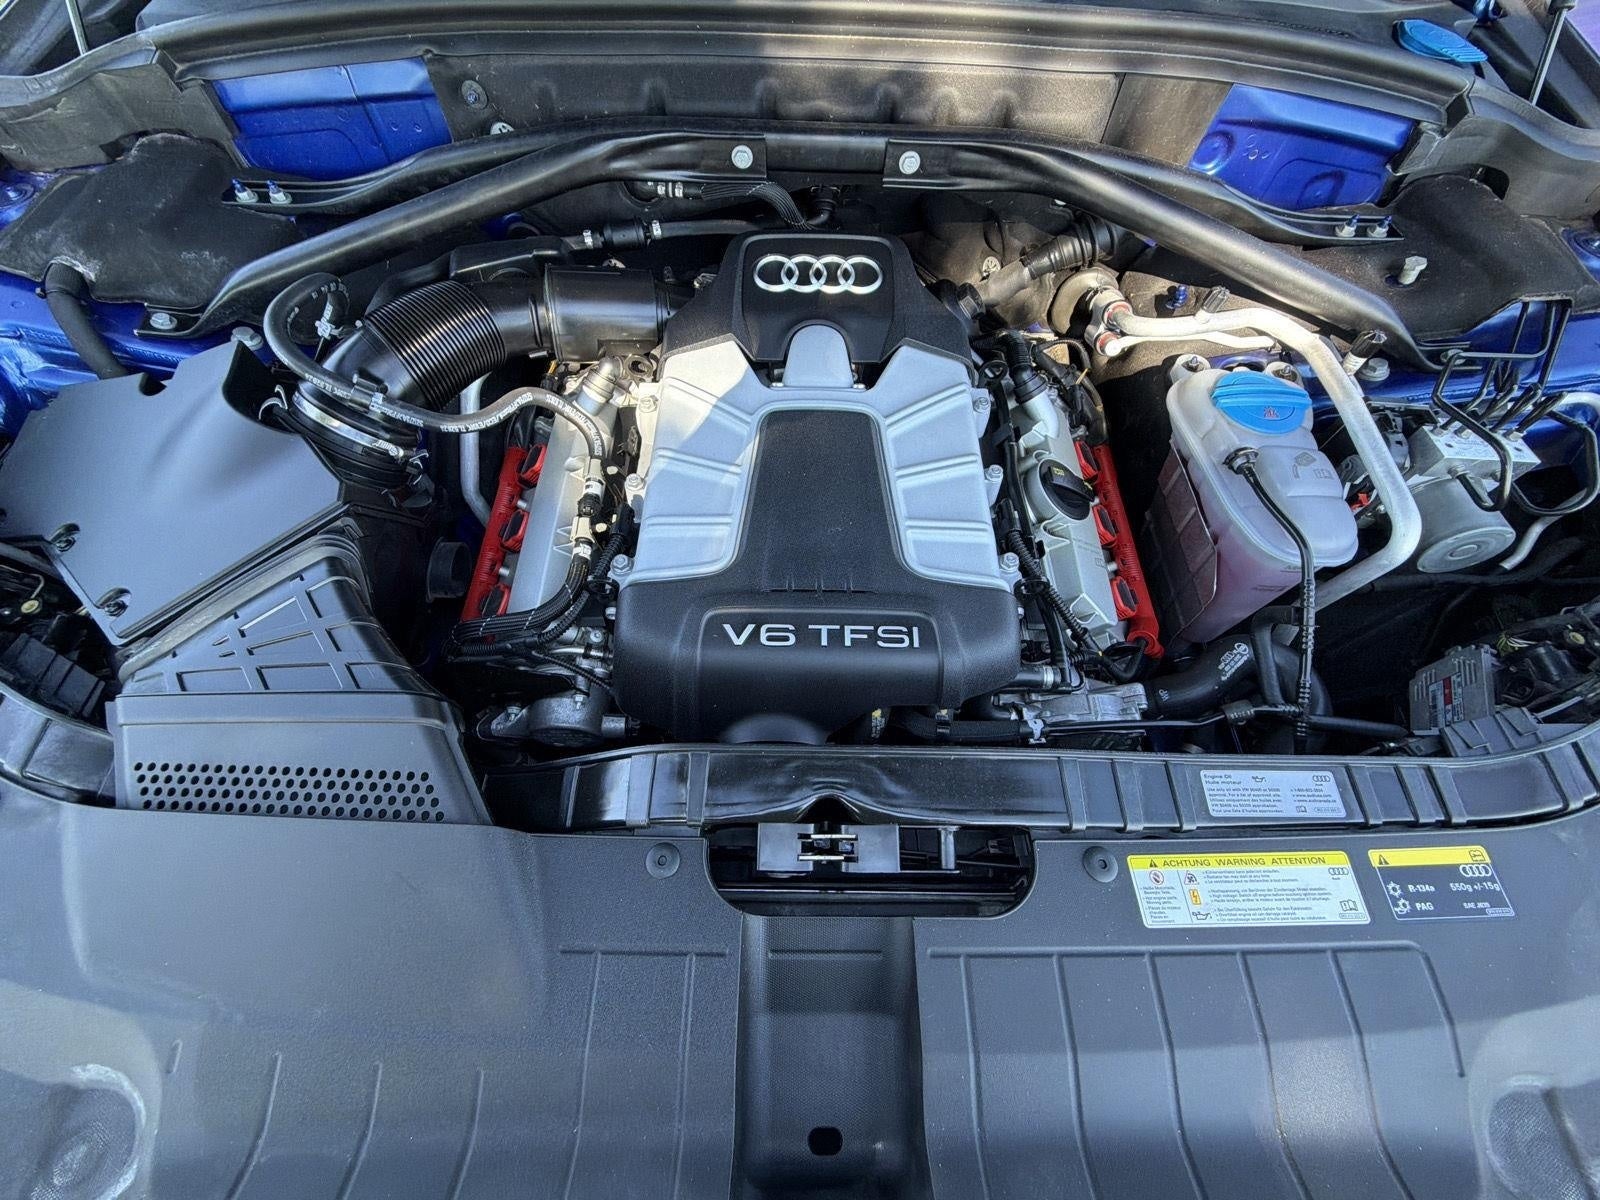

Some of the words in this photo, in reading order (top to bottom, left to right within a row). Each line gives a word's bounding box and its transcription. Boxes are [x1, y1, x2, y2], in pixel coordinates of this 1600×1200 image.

[722, 623, 796, 646] V6
[808, 624, 920, 648] TFSI
[1163, 859, 1211, 867] ACHTUNG
[1215, 857, 1266, 866] WARNING
[1271, 856, 1326, 865] ATTENTION
[1408, 883, 1435, 893] R-134a
[1450, 882, 1473, 892] 550g
[1415, 902, 1434, 911] PAG
